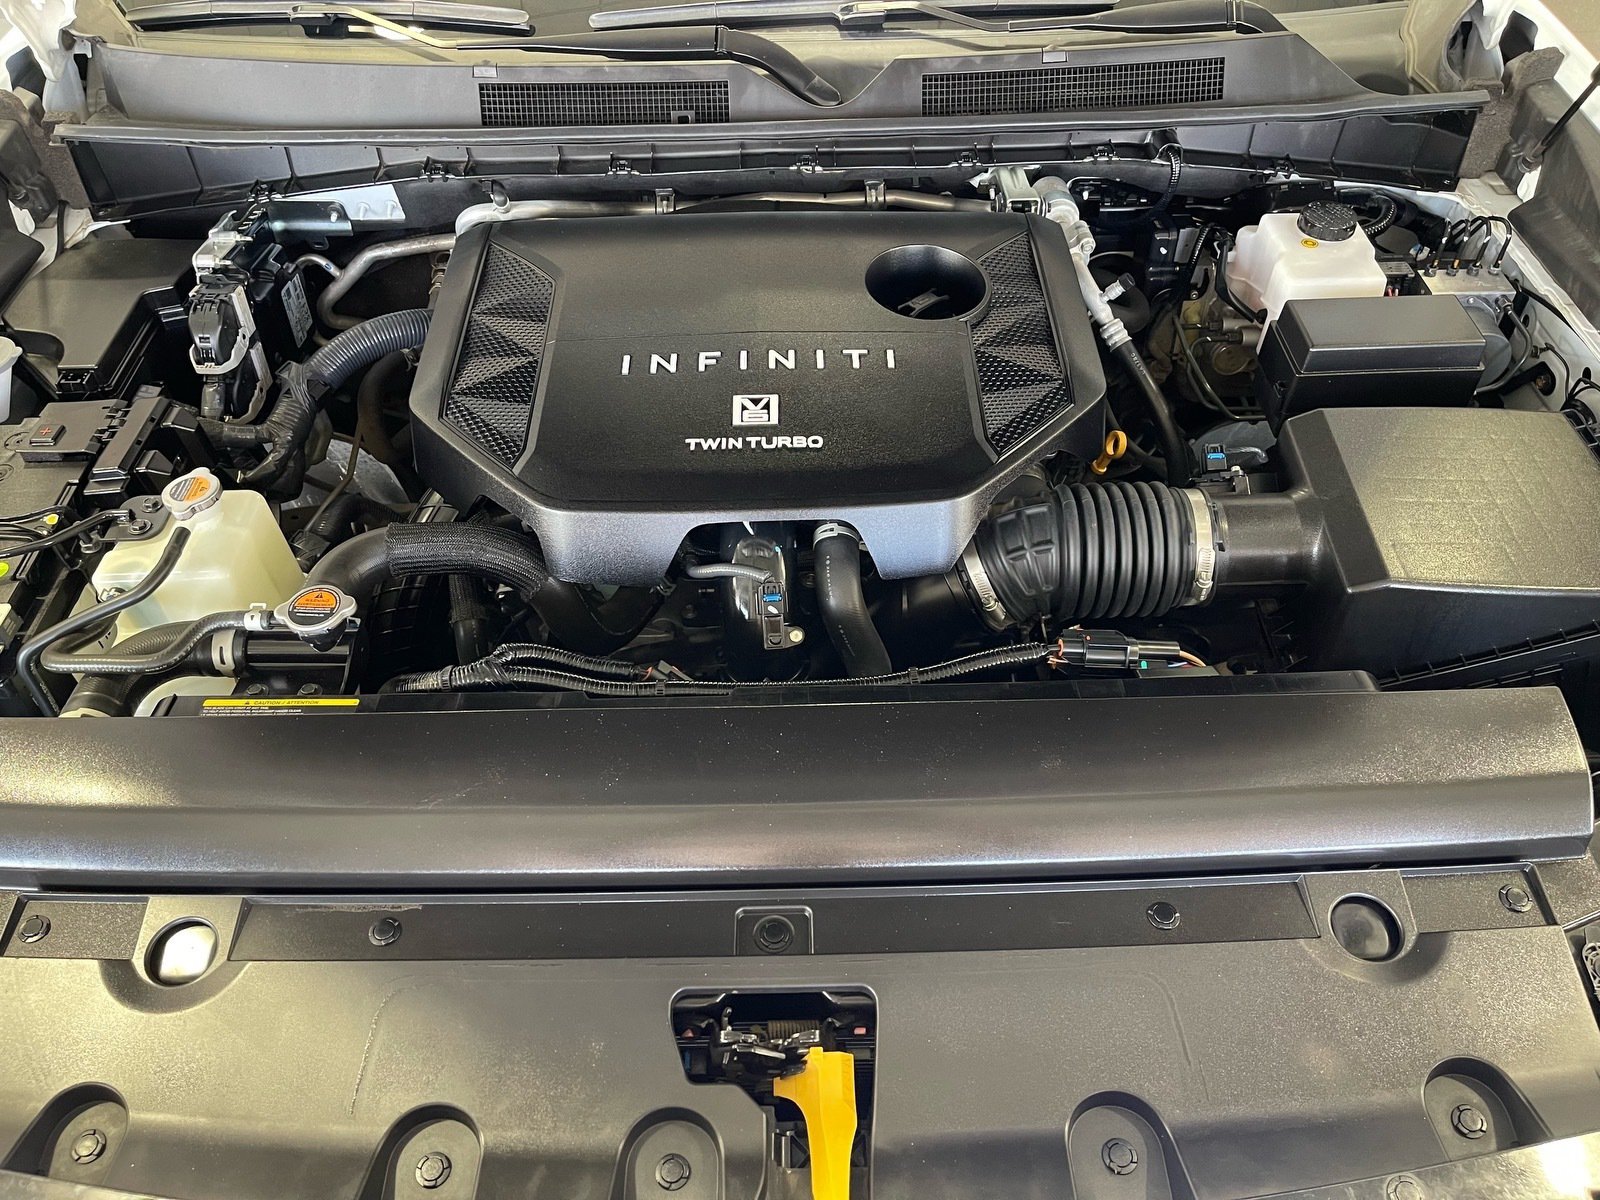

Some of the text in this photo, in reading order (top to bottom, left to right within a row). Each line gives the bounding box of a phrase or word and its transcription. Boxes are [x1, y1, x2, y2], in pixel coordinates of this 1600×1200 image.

[620, 349, 896, 376] INFINITI
[738, 397, 771, 423] V6
[684, 435, 824, 450] TWIN TURBO
